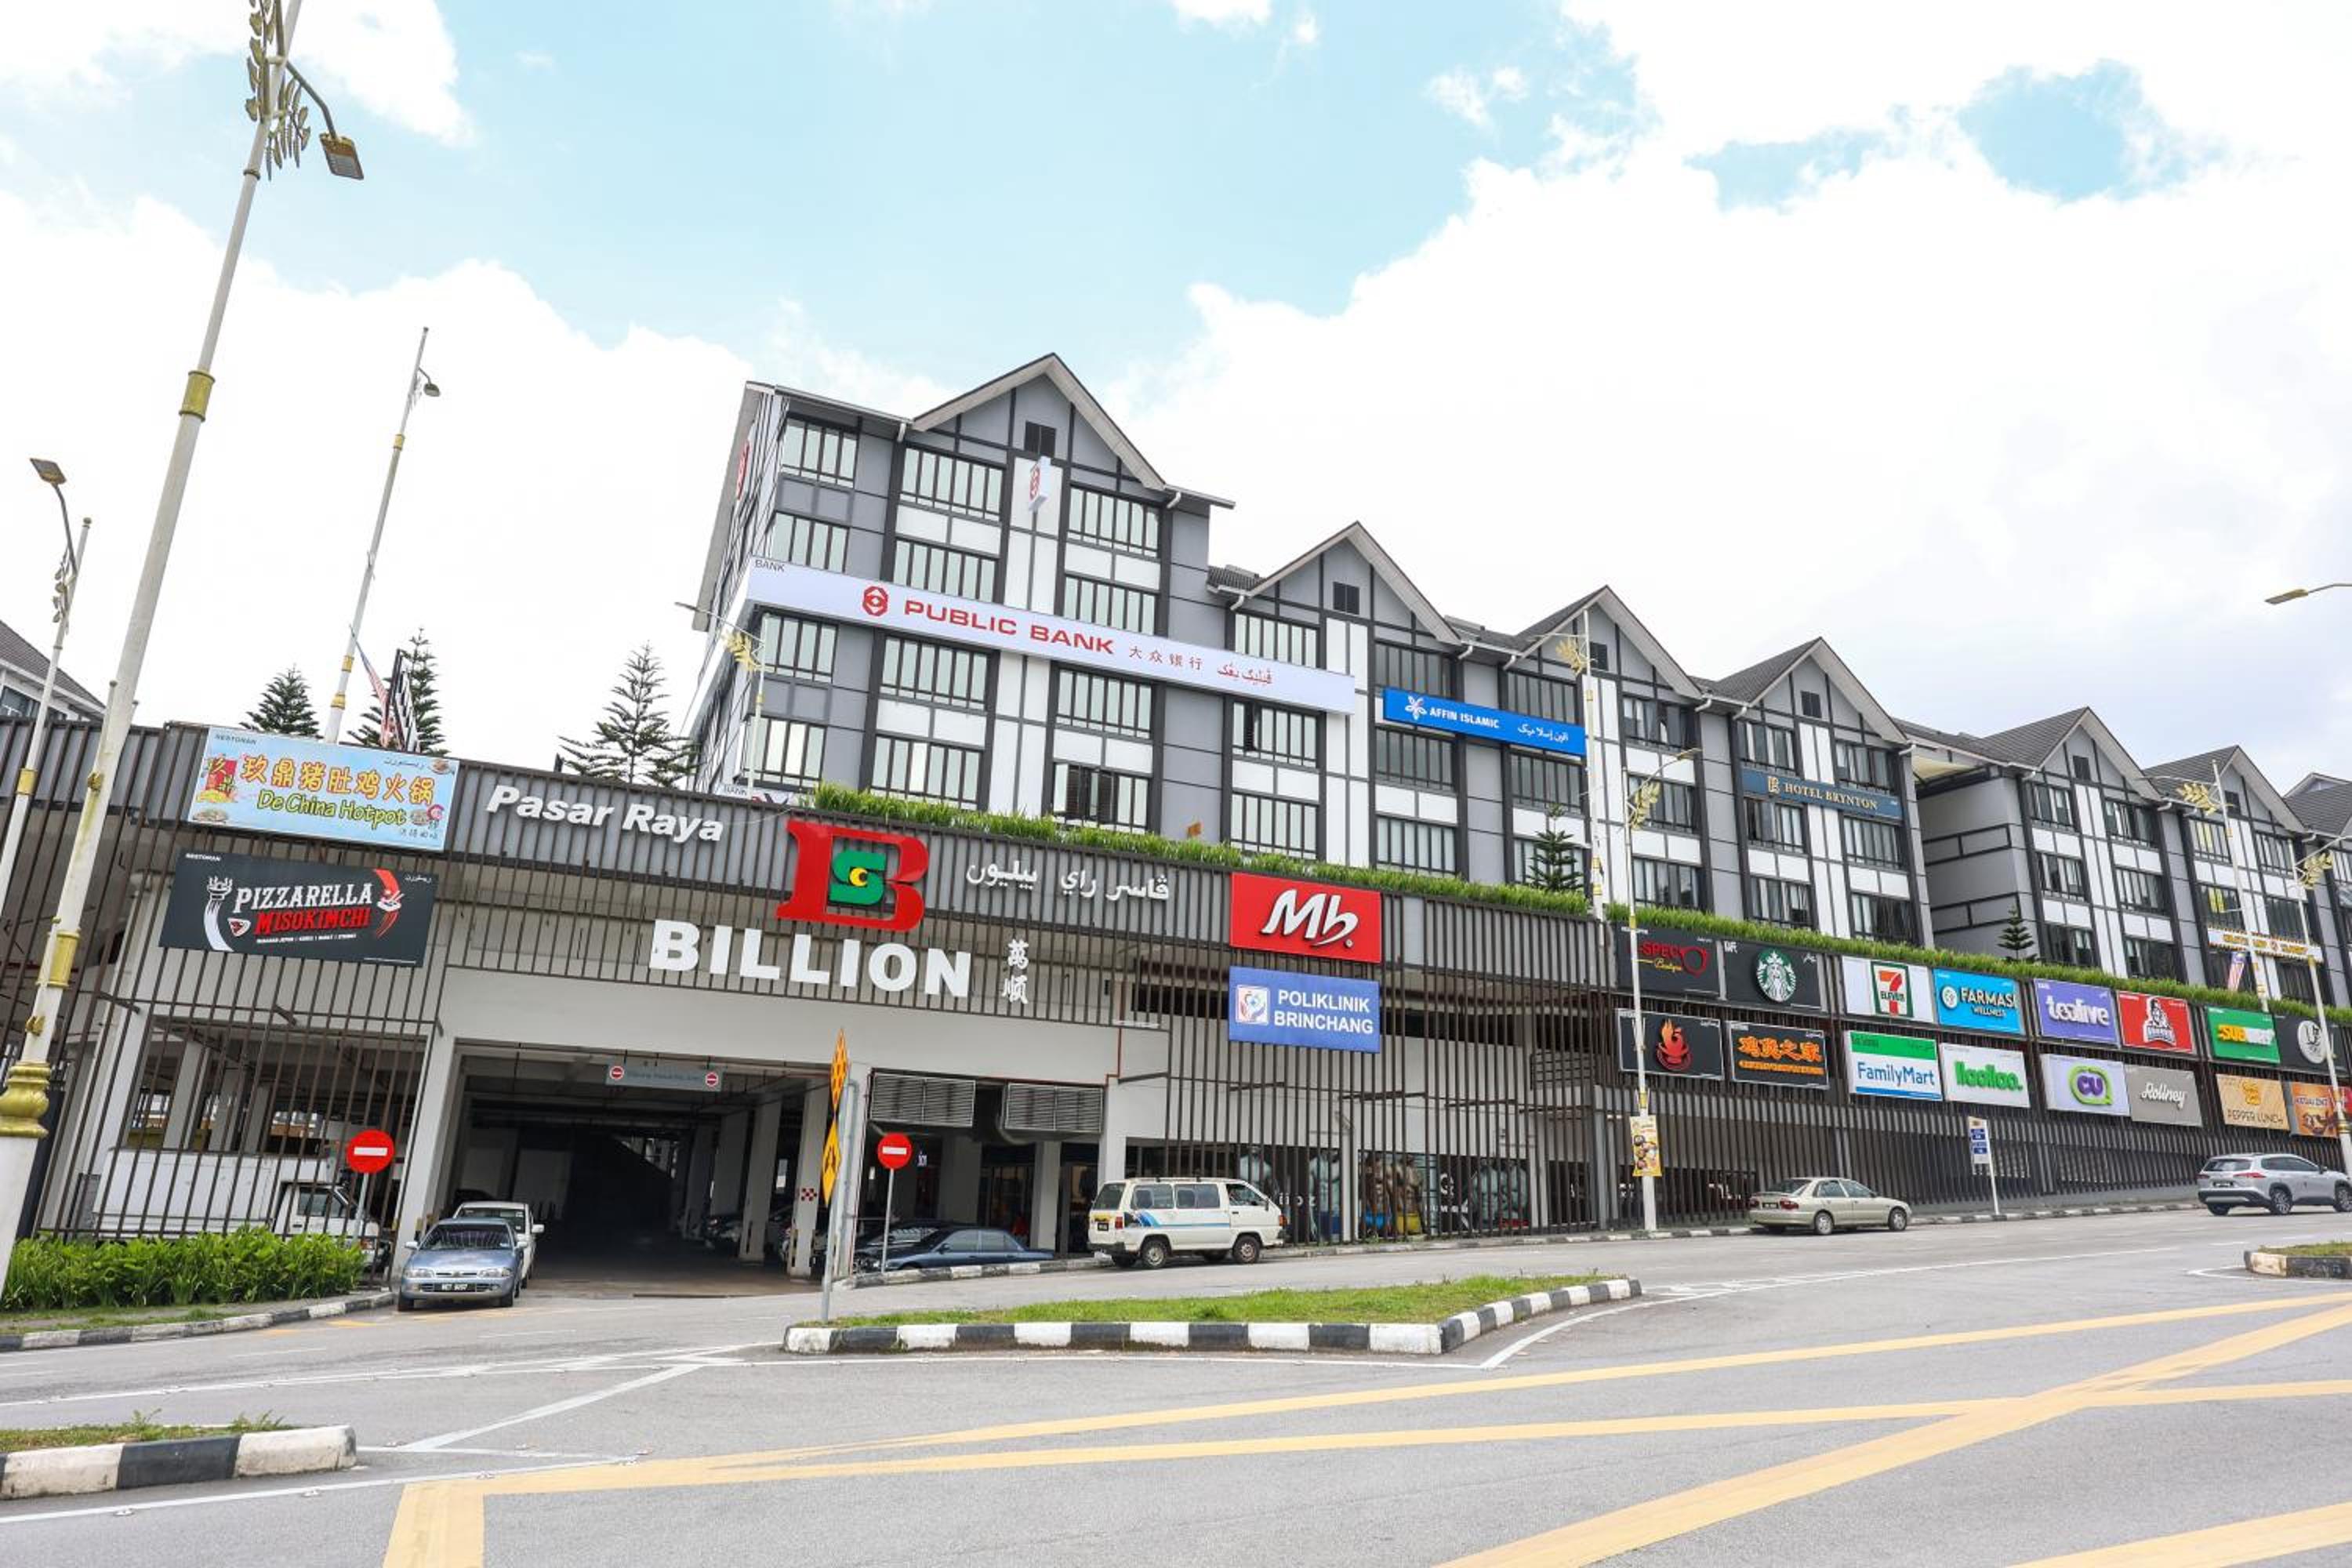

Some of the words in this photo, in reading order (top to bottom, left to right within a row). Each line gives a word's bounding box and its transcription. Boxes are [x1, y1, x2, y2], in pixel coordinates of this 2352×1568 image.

[904, 600, 1017, 636] PUBLIC
[1029, 624, 1115, 655] BANK
[1129, 645, 1203, 670] 大众银行
[1429, 706, 1457, 721] AFFIN
[1461, 713, 1500, 729] ISLAMIC
[240, 754, 435, 806] 玖鼎猪肚鸡火锅
[257, 789, 284, 811] De
[286, 792, 336, 818] China
[339, 800, 407, 830] Hotpot
[1784, 782, 1822, 799] HOTEL
[1825, 791, 1878, 811] BRYNTON
[486, 785, 615, 826] Pasar
[622, 803, 724, 844] Raya
[233, 883, 374, 914] PIZZARELLA
[648, 919, 972, 998] BILLION
[1278, 989, 1370, 1013] POLIKLINIK
[1878, 971, 1903, 1017] 7
[1961, 987, 2016, 1008] FARMASI
[1274, 1011, 1374, 1034] BRINCHANG
[2046, 995, 2111, 1026] tealive
[1857, 1062, 1935, 1086] FamilyMart
[2077, 1075, 2103, 1096] CU
[2227, 1109, 2256, 1122] PEPPER
[2257, 1110, 2283, 1125] LUNCH
